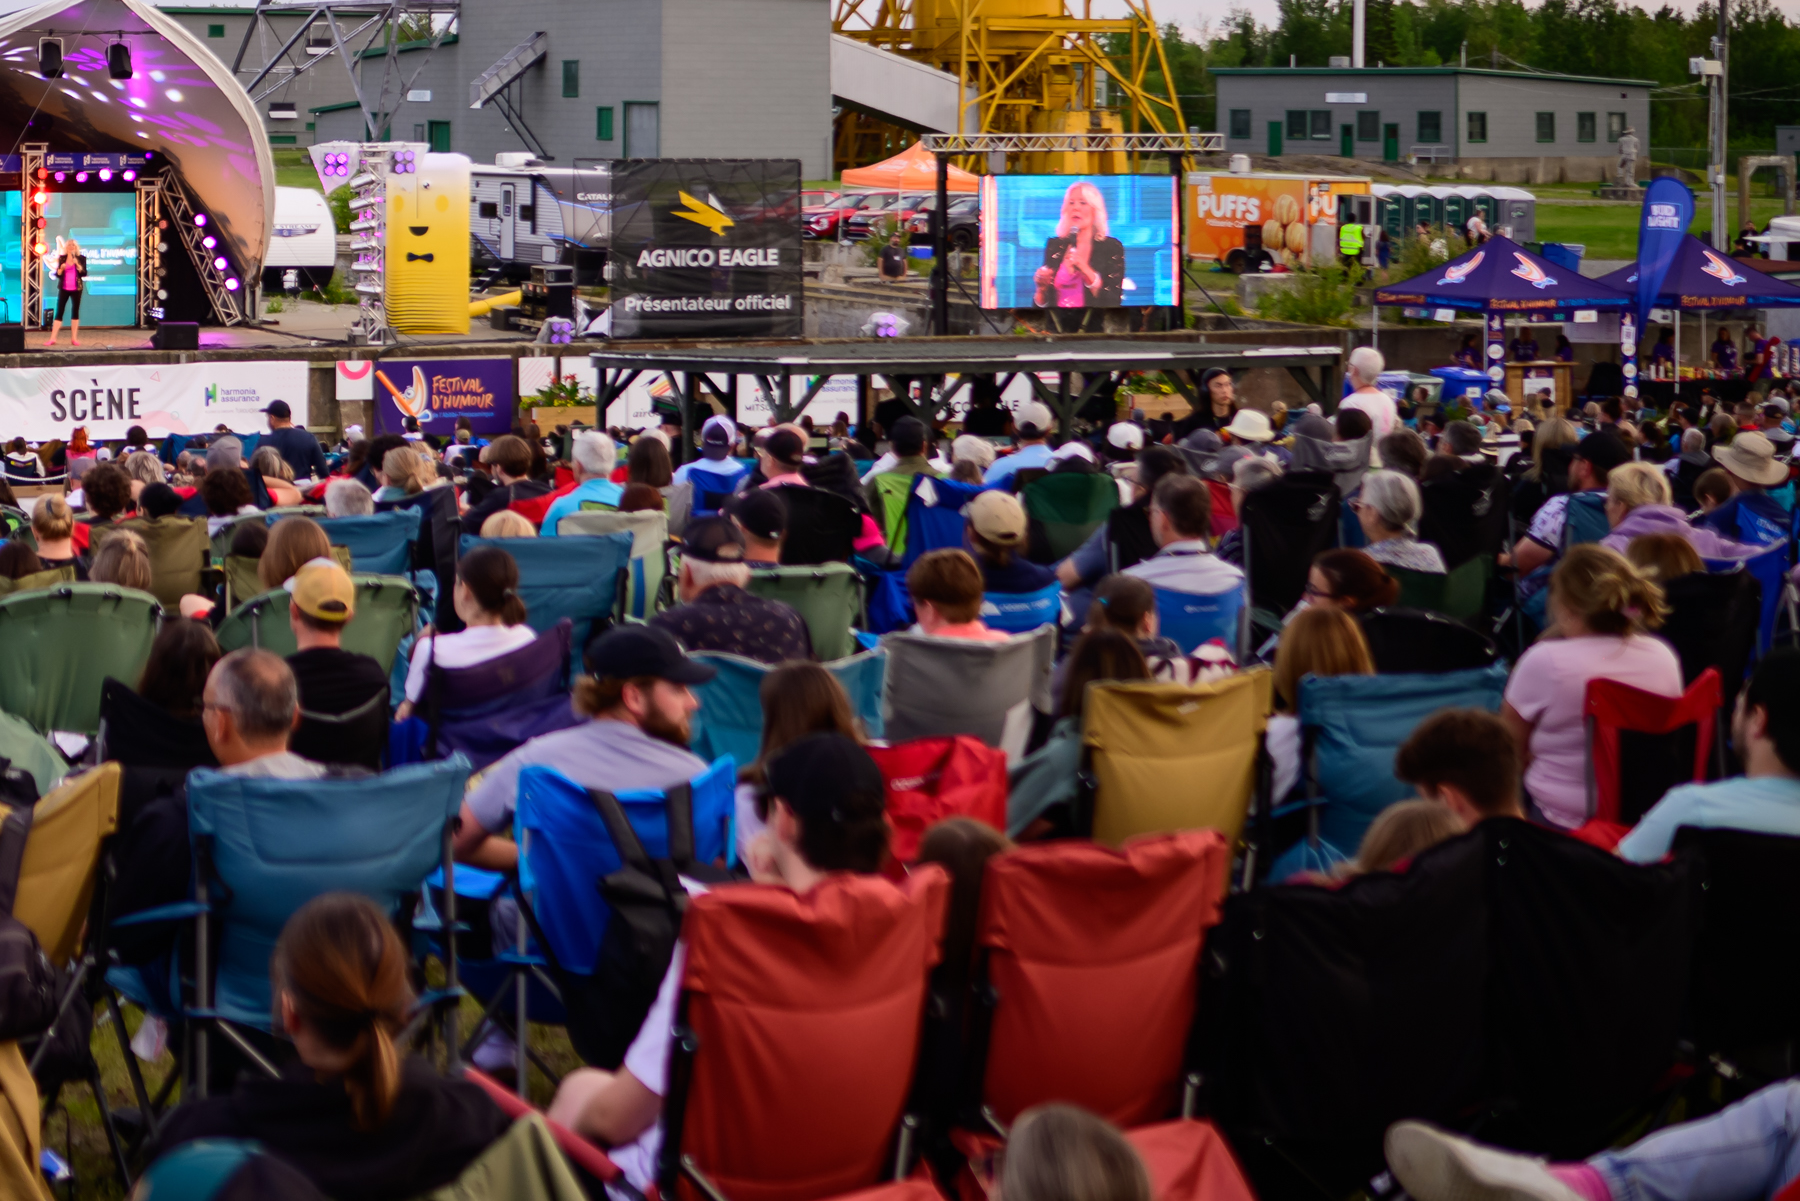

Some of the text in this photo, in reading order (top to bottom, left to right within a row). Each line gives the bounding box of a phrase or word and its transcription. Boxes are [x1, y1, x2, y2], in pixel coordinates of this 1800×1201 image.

[1197, 195, 1261, 222] PUFFS
[1651, 204, 1676, 216] BUD
[637, 248, 779, 268] AGNICO EAGLE
[625, 295, 791, 312] Présentateur officiel
[220, 387, 256, 395] harmonia
[432, 375, 484, 394] FESTIVAL
[50, 378, 141, 422] SCÈNE
[432, 393, 494, 410] D'HUMOUR
